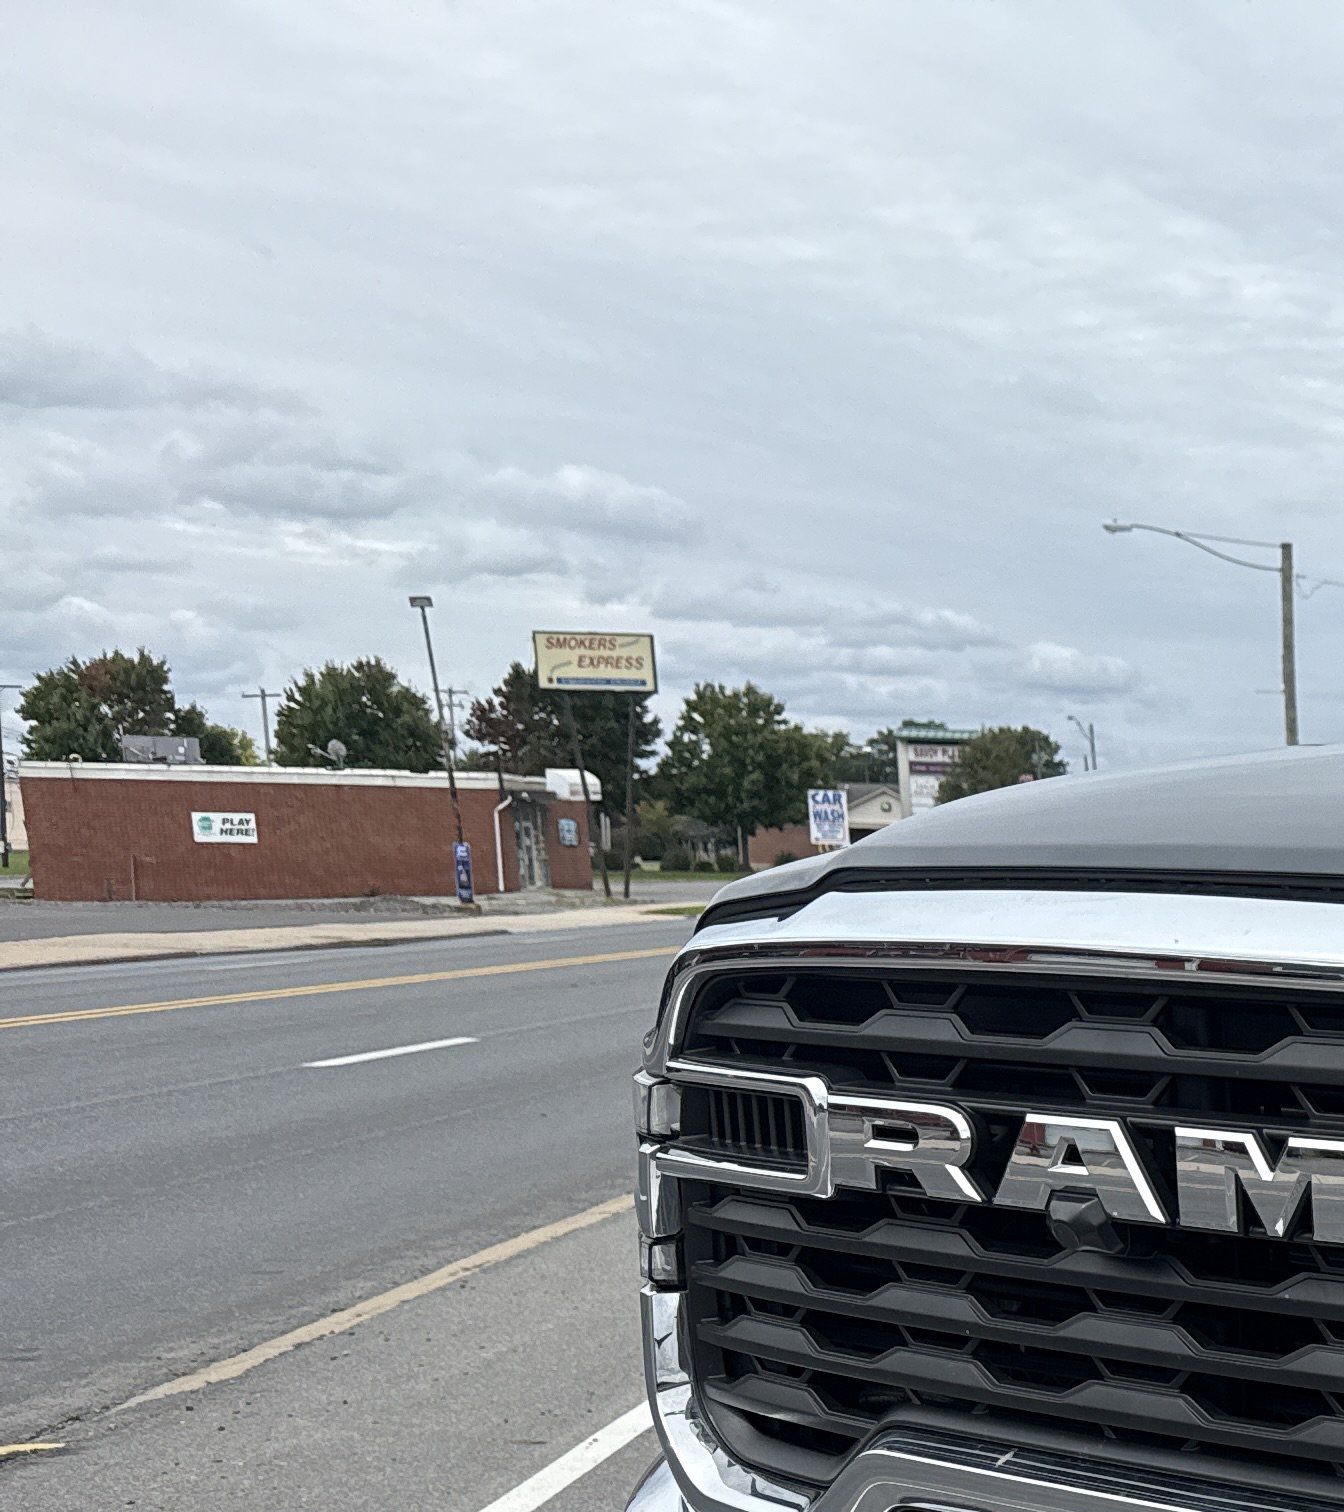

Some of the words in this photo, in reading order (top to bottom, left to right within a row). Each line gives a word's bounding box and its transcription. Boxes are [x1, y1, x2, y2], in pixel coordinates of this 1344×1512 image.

[545, 636, 618, 651] SMOKERS
[577, 655, 645, 670] EXPRESS
[811, 791, 843, 808] CAR
[221, 817, 252, 827] PLAY
[813, 809, 845, 823] WASH
